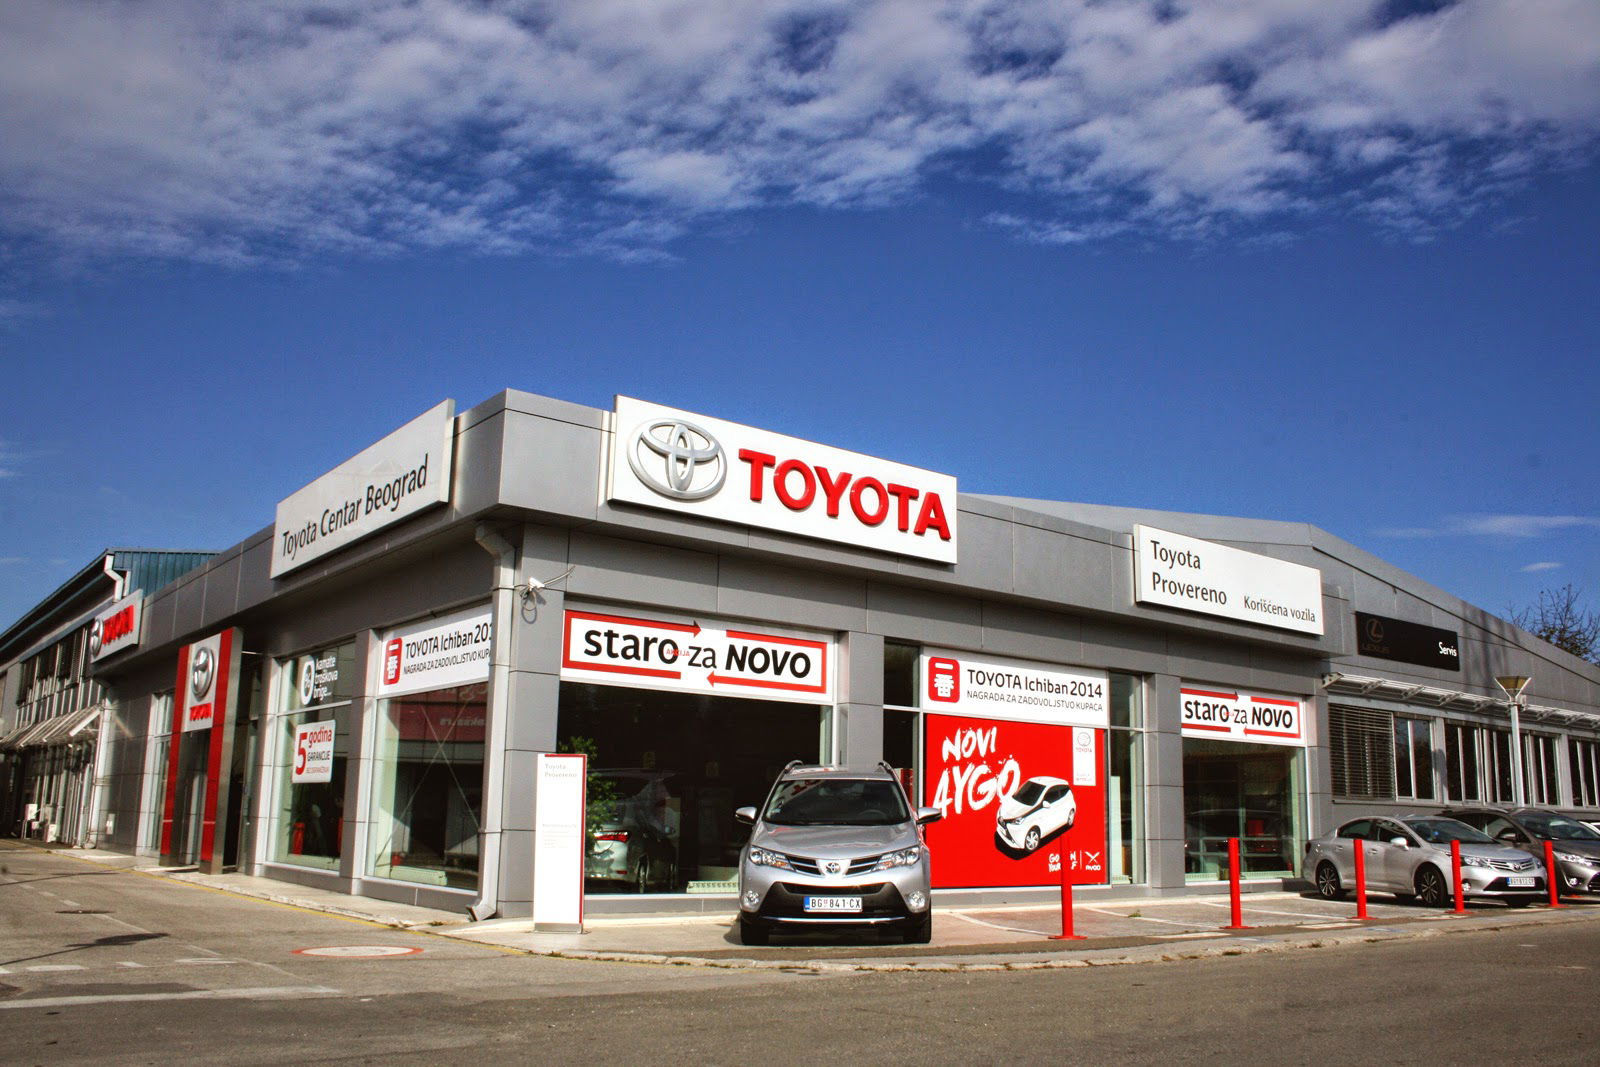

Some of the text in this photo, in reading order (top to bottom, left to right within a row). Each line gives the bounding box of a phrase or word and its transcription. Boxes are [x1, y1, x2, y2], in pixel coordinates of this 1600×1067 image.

[283, 453, 429, 561] Toyota Centar Beograd
[739, 448, 951, 541] TOYOTA
[1150, 540, 1201, 569] Toyota
[1152, 571, 1228, 605] Provereno
[1243, 595, 1316, 622] Korišćena vozila
[406, 636, 439, 659] TOYOTA
[440, 631, 473, 651] Ichiban
[584, 628, 811, 679] staro za NOVO
[1438, 641, 1457, 657] Servis
[403, 660, 427, 674] NAGRADA
[427, 662, 435, 671] ZA
[434, 650, 478, 669] ZADOVOLJSTVO
[967, 669, 1103, 698] TOYOTA Ichiban 2014
[966, 690, 1103, 712] NAGRADA ZA ZADOVOLJSTVO KUPACA
[1184, 700, 1293, 729] staro za NOVO
[295, 726, 332, 776] 5 godina
[942, 726, 997, 763] NOVI
[932, 757, 1021, 819] AYGO
[811, 899, 823, 908] BG
